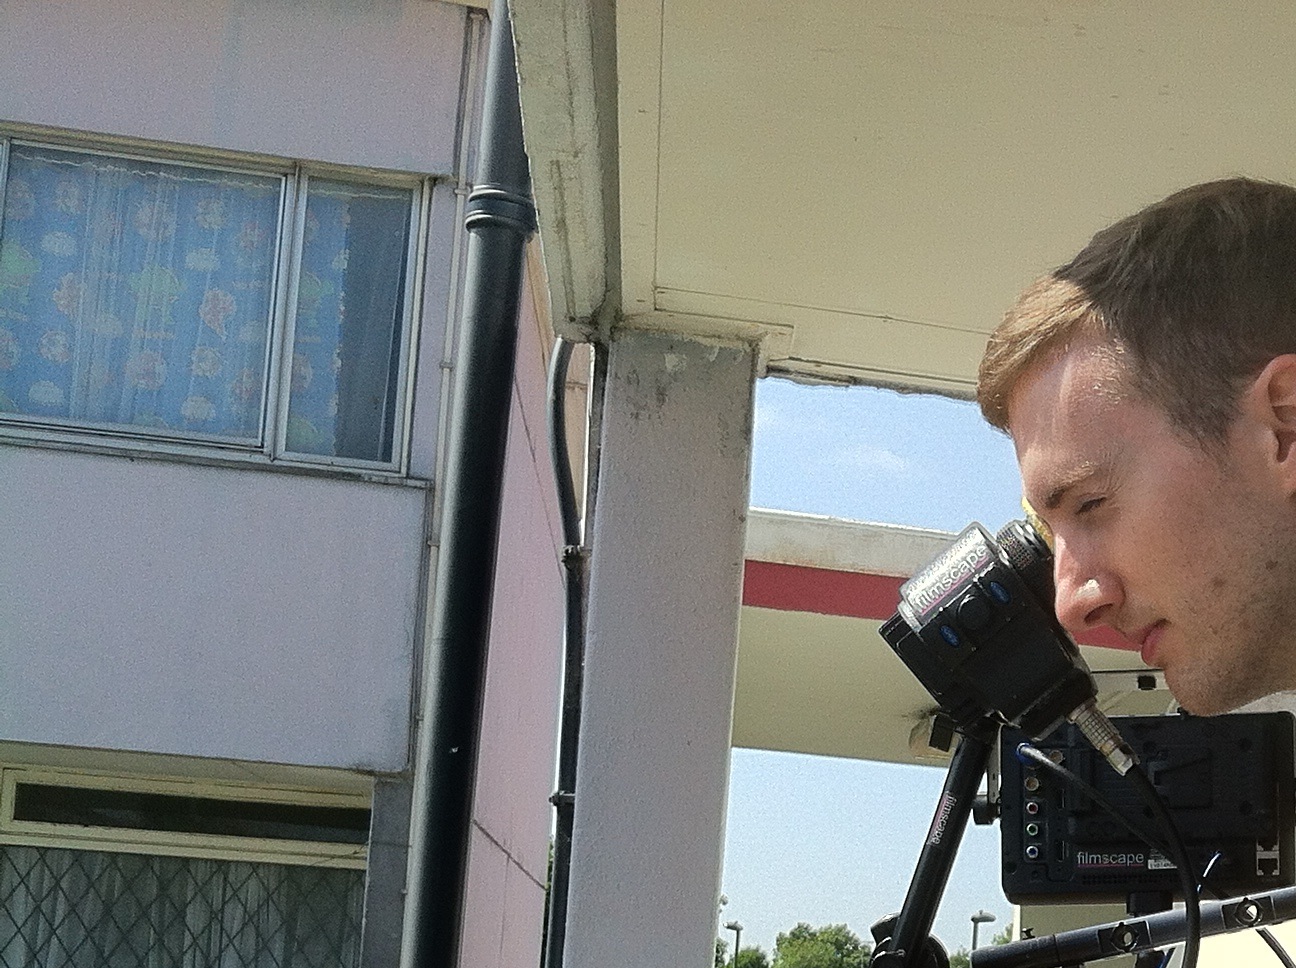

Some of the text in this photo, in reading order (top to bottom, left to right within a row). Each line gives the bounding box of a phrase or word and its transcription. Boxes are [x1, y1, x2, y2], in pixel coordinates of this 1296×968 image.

[914, 544, 988, 614] filmscape
[932, 792, 957, 845] filmscape
[1077, 851, 1144, 867] filmscape
